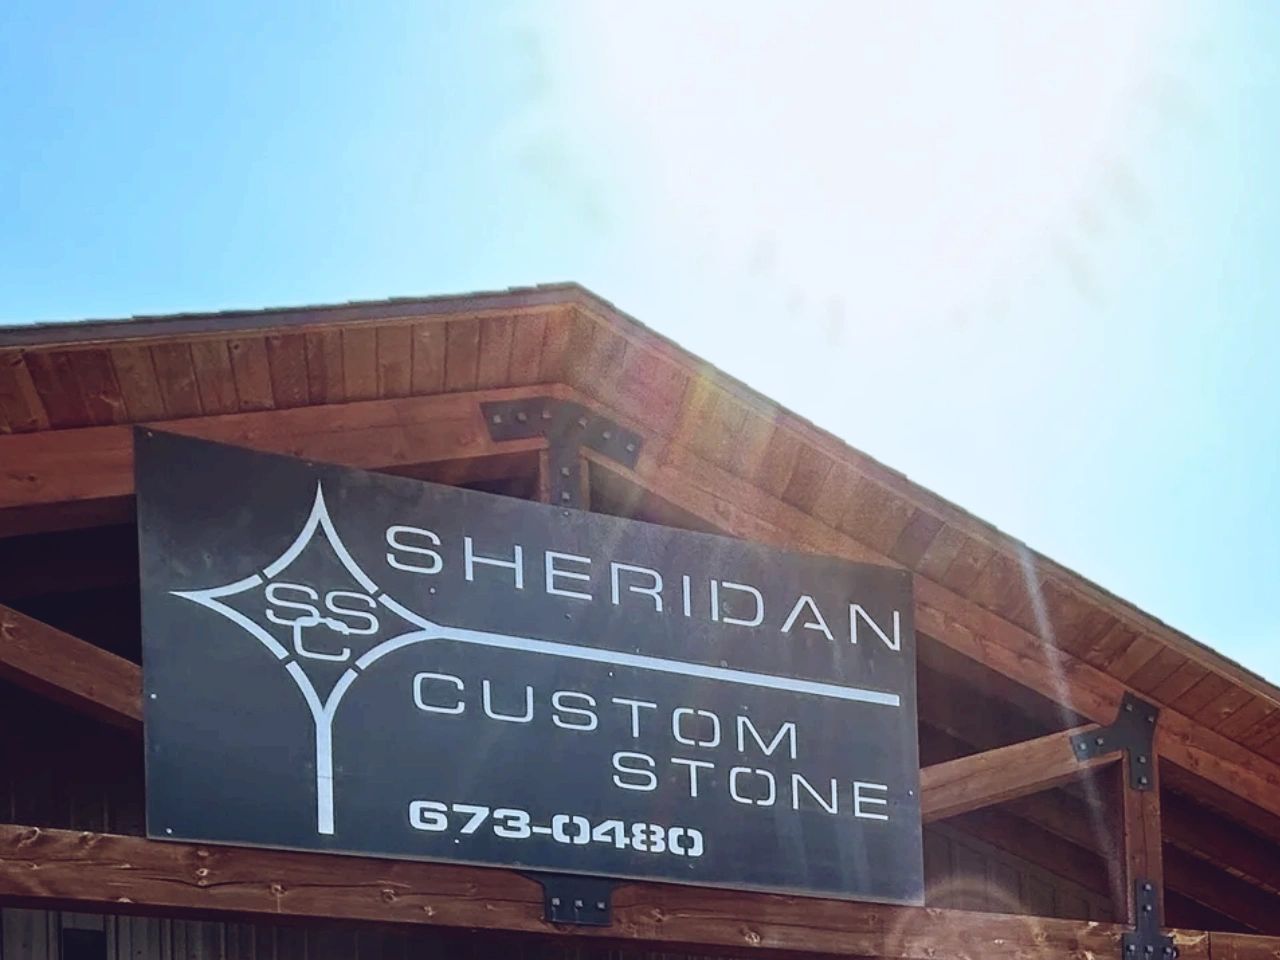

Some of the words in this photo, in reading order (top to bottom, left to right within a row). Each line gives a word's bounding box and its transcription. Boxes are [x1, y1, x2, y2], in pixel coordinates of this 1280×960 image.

[386, 525, 901, 652] SHERIDAN
[412, 672, 798, 760] CUSTOM
[612, 752, 889, 821] STONE
[408, 800, 705, 858] 673-0480
